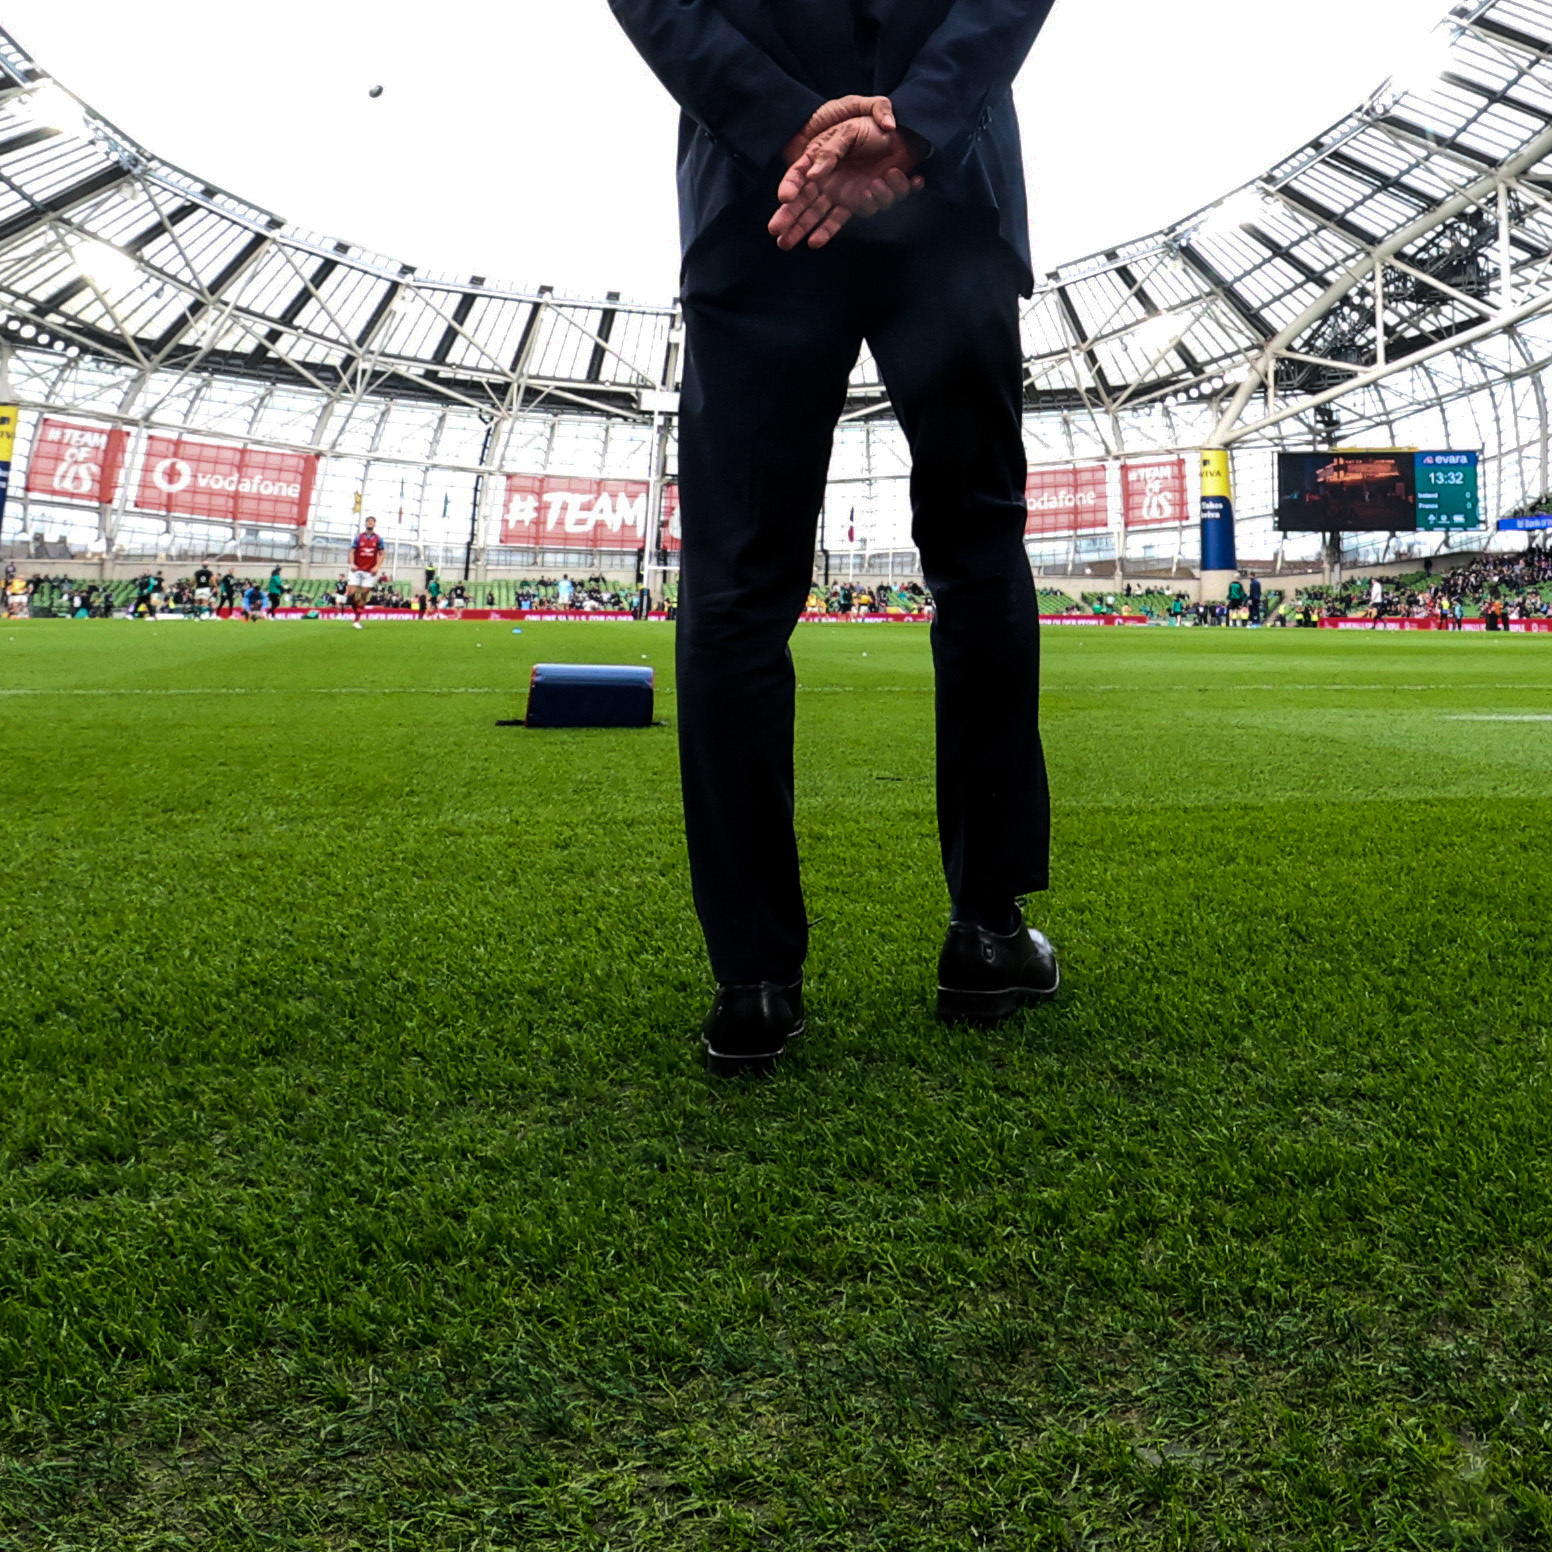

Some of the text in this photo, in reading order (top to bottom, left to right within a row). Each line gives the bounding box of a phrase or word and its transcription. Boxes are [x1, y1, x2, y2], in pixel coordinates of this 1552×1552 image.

[48, 427, 108, 447] #TEAM
[64, 446, 91, 462] OF
[1435, 455, 1468, 464] evara
[52, 461, 101, 494] US
[197, 472, 301, 498] vodafone
[1429, 471, 1464, 485] 13:32
[1027, 491, 1097, 511] odafone
[1141, 491, 1173, 519] US
[505, 491, 647, 538] #TEAM
